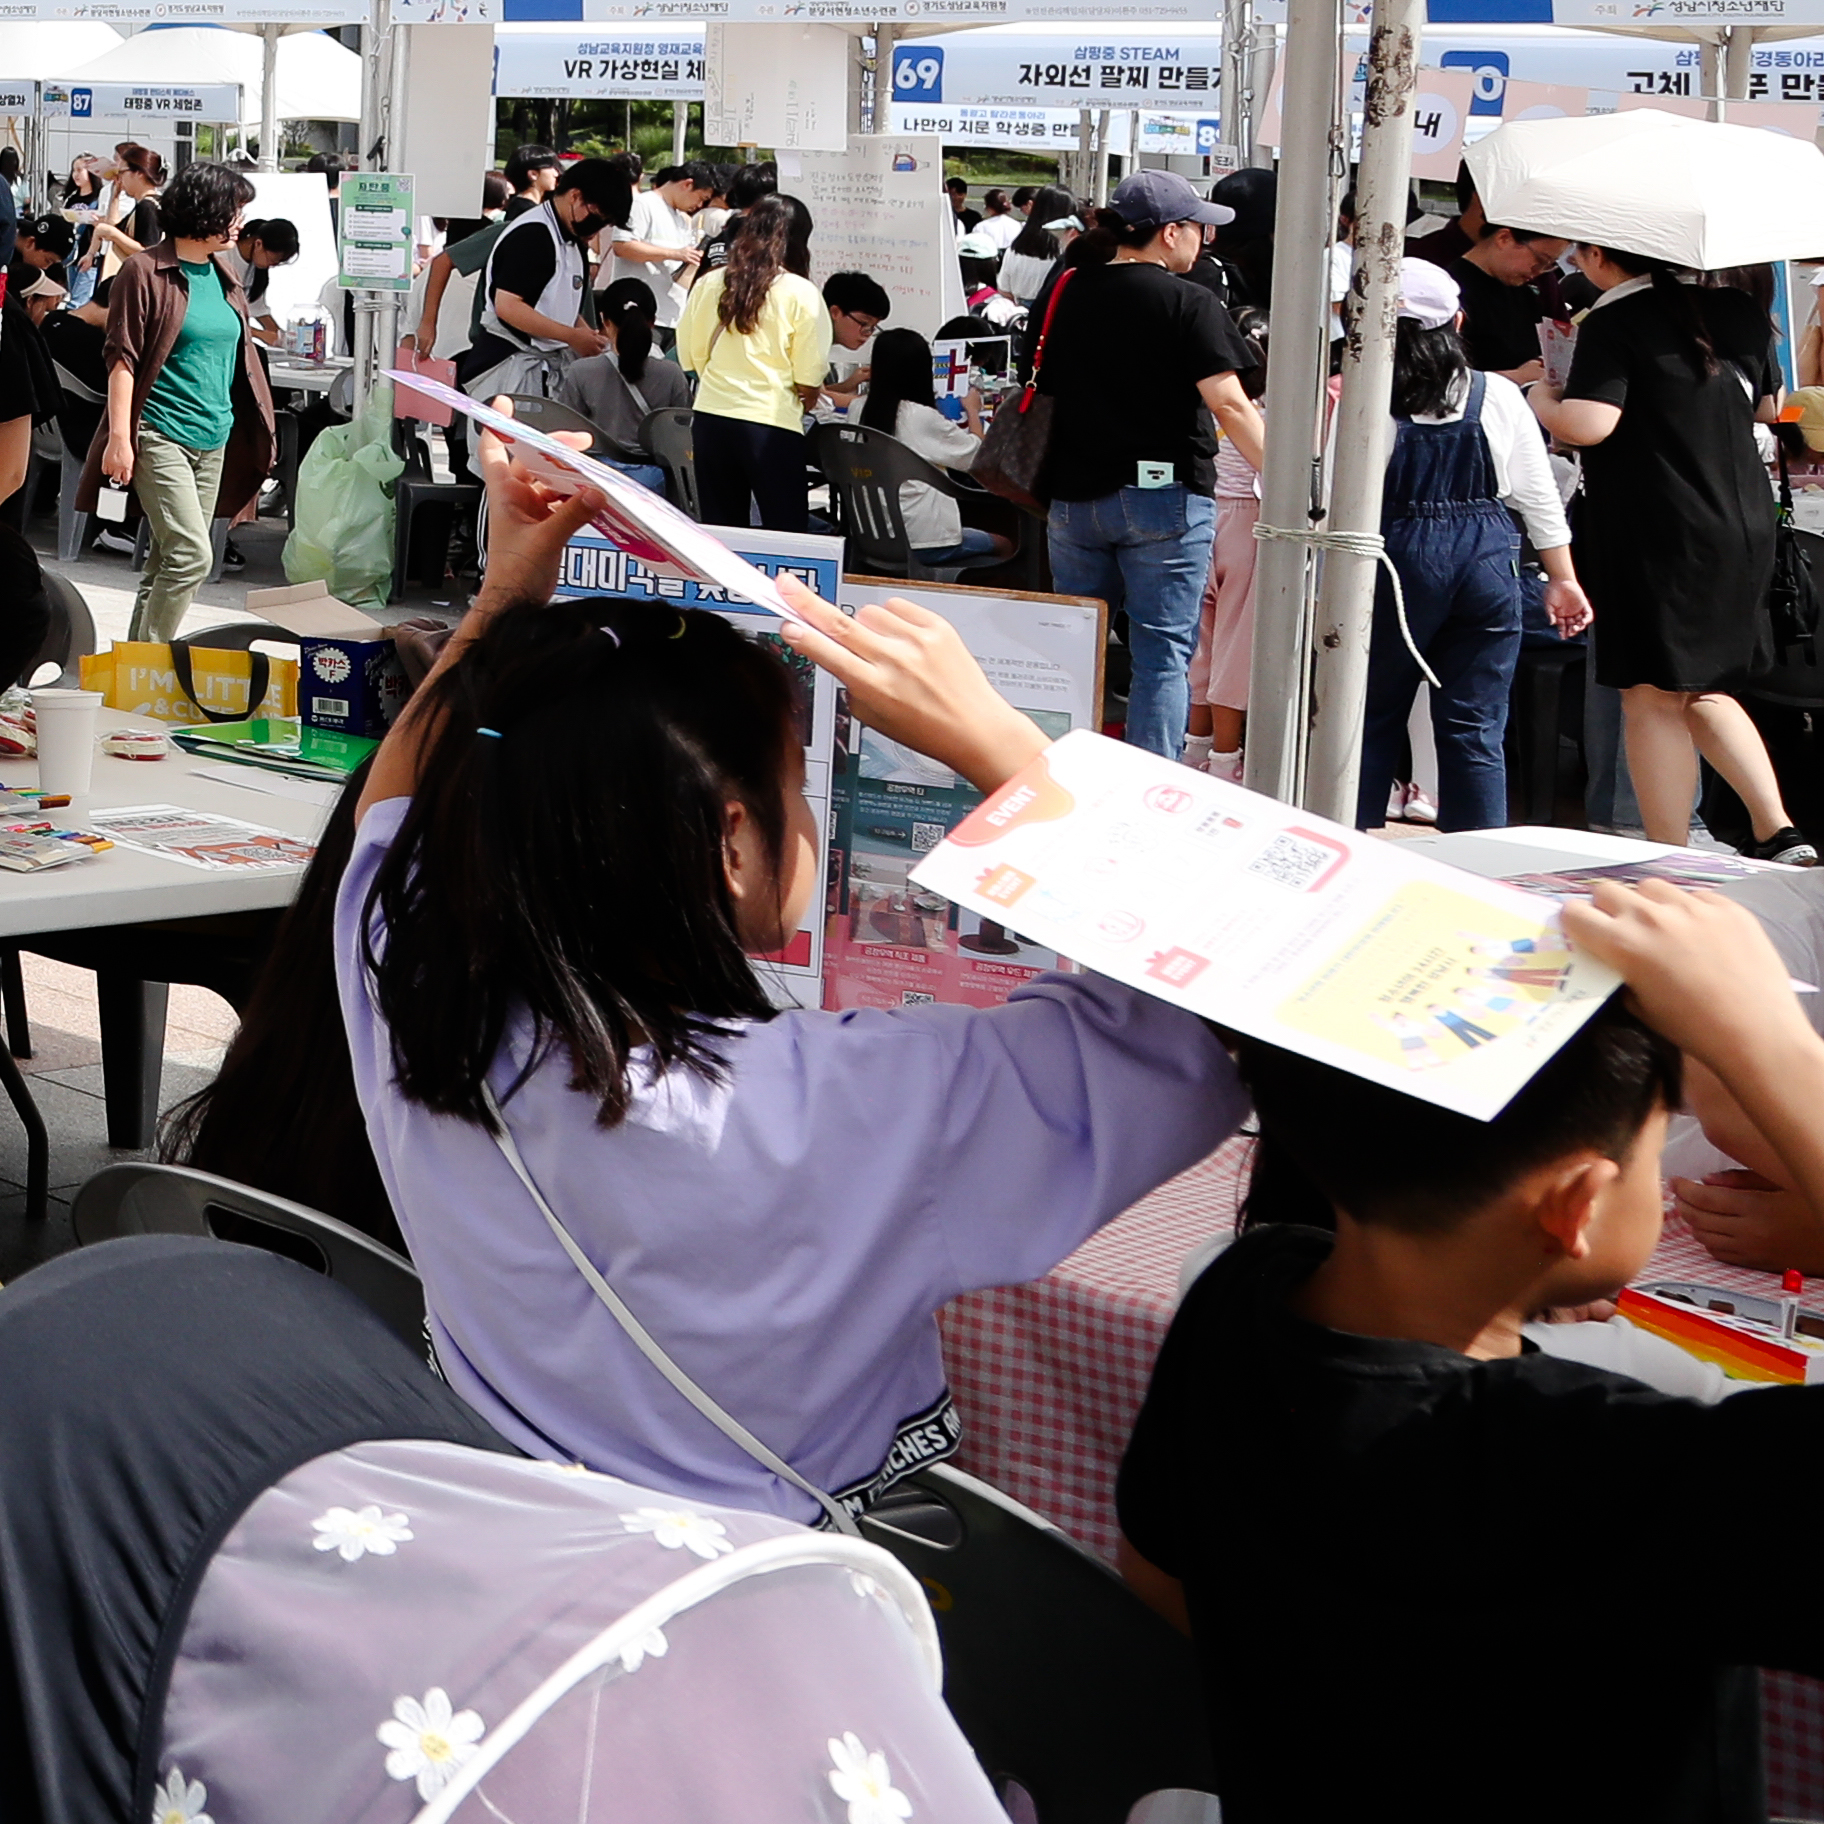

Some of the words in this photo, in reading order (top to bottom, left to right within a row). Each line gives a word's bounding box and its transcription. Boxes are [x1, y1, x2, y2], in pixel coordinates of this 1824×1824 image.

[922, 0, 1007, 12] 경기도성남교육지원청
[1668, 0, 1785, 13] 성남시청소년재단
[577, 43, 656, 56] 성남교육지원청
[1074, 47, 1115, 61] 삼평중
[1120, 47, 1180, 61] STEAM
[564, 61, 593, 78] VR
[599, 59, 678, 81] 가상현실
[894, 58, 940, 89] 69
[1018, 65, 1091, 87] 자외선
[1101, 64, 1149, 88] 팔찌
[72, 95, 92, 110] 87
[156, 98, 170, 110] VR
[903, 118, 952, 133] 나만의
[959, 120, 990, 134] 지문
[996, 122, 1046, 136] 학생증
[851, 467, 873, 478] VIP
[318, 656, 348, 671] 박카스
[130, 667, 175, 693] I'M
[328, 669, 336, 679] F
[986, 784, 1038, 827] EVENT
